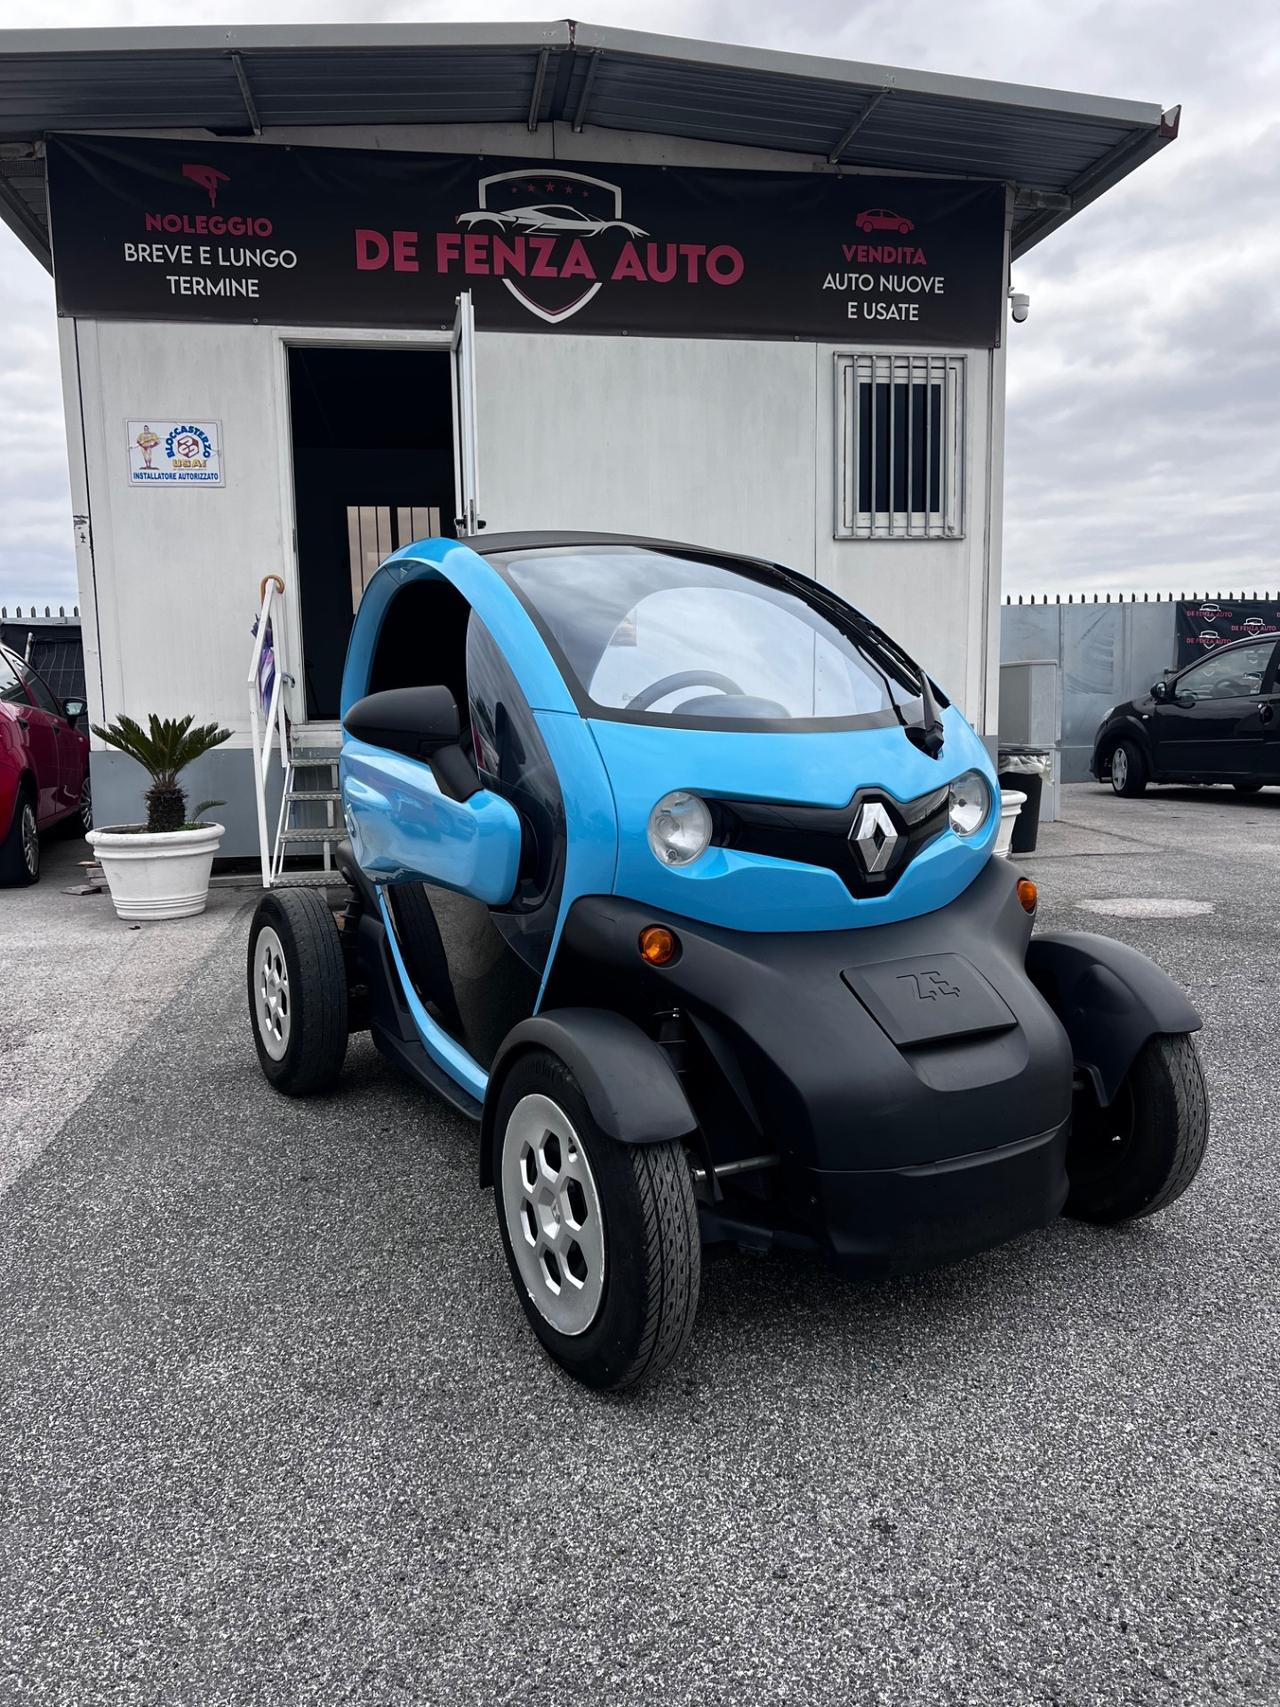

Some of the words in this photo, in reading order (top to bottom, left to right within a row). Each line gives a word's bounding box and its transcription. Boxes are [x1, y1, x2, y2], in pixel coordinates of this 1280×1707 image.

[145, 213, 273, 237] NOLEGGIO
[124, 243, 193, 264] BREVE
[199, 246, 212, 265] E
[218, 247, 297, 269] LUNGO
[355, 229, 419, 272] DE
[436, 232, 596, 280] FENZA
[611, 242, 745, 286] AUTO
[841, 244, 927, 265] VENDITA
[166, 275, 260, 298] TERMINE
[822, 272, 874, 291] AUTO
[879, 275, 945, 294] NUOVE
[847, 301, 858, 318] E
[863, 302, 919, 321] USATE
[165, 426, 212, 459] BLOCCASTERZO
[133, 471, 177, 480] INSTALLATORE
[178, 472, 218, 481] AUTORIZZATO
